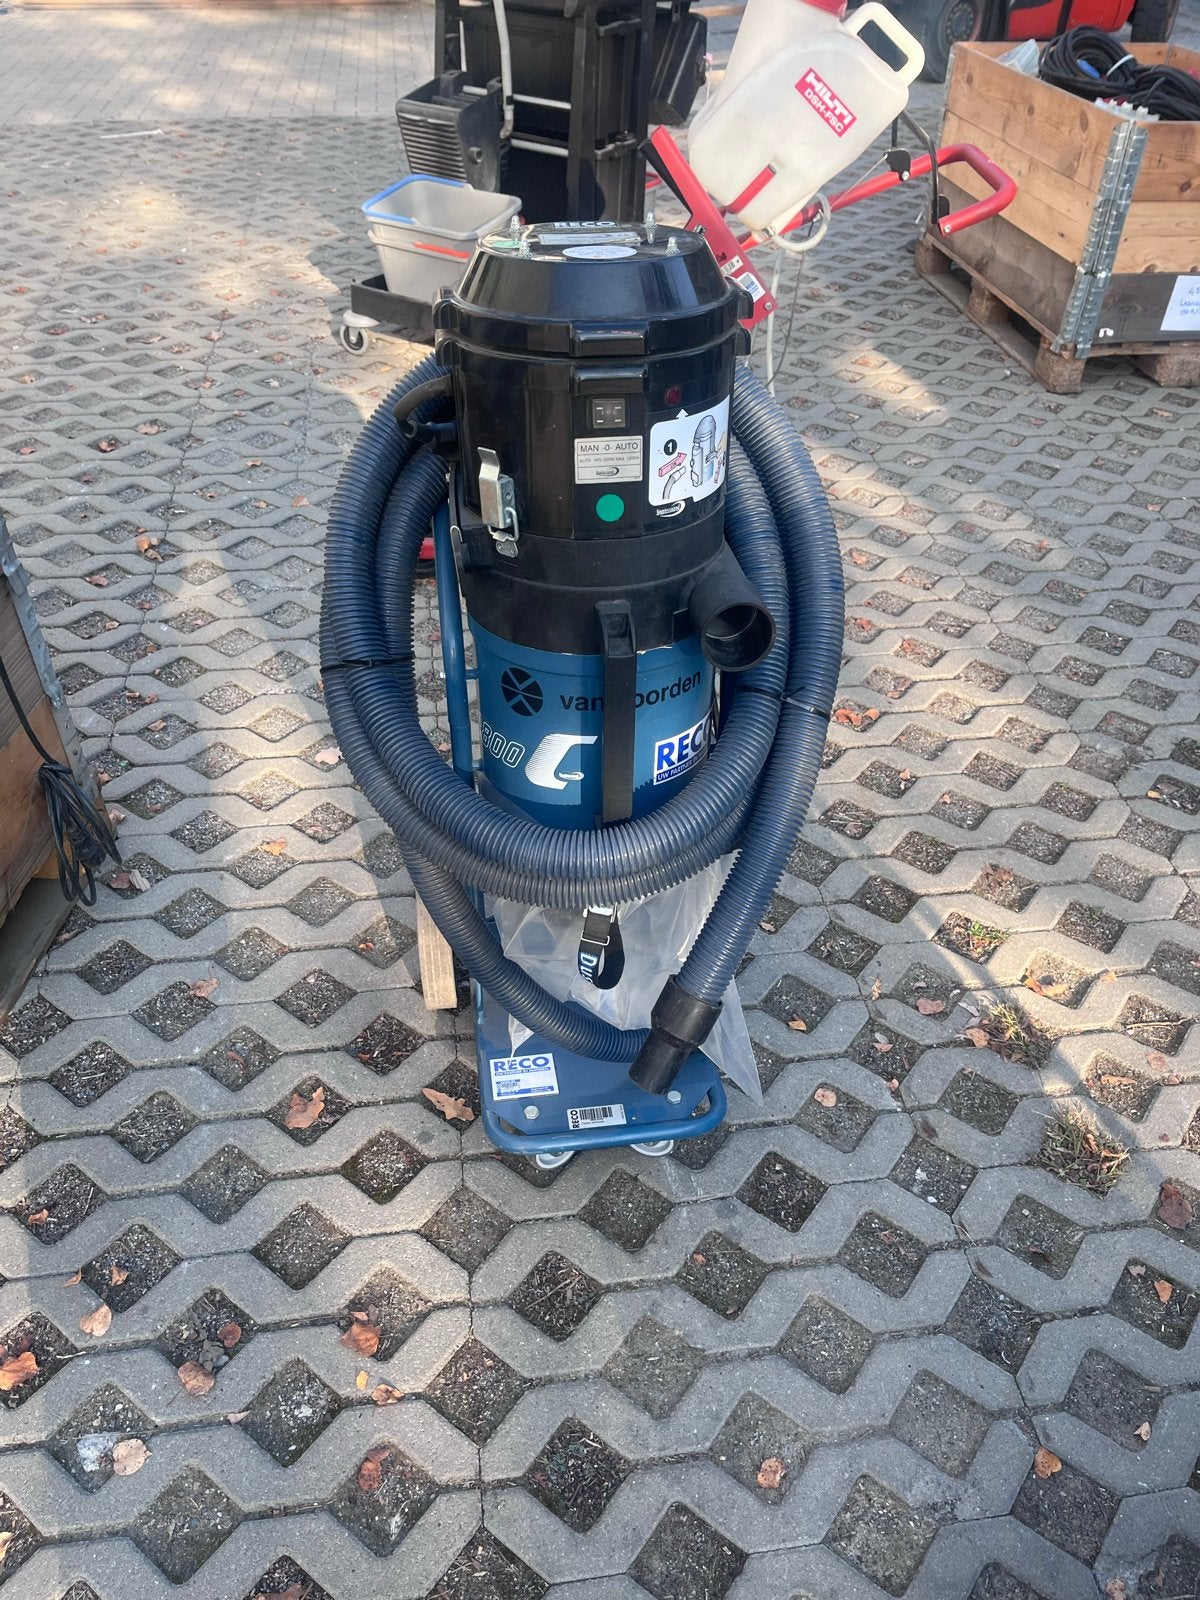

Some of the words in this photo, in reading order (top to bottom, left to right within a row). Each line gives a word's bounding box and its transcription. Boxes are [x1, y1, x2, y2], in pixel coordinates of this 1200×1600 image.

[804, 71, 855, 125] HILTI
[804, 88, 844, 132] DSH-FSC
[580, 444, 600, 452] MAN
[615, 442, 639, 450] AUTO
[635, 671, 701, 709] oorden
[493, 1056, 550, 1072] RECO
[570, 1110, 580, 1129] RECO
